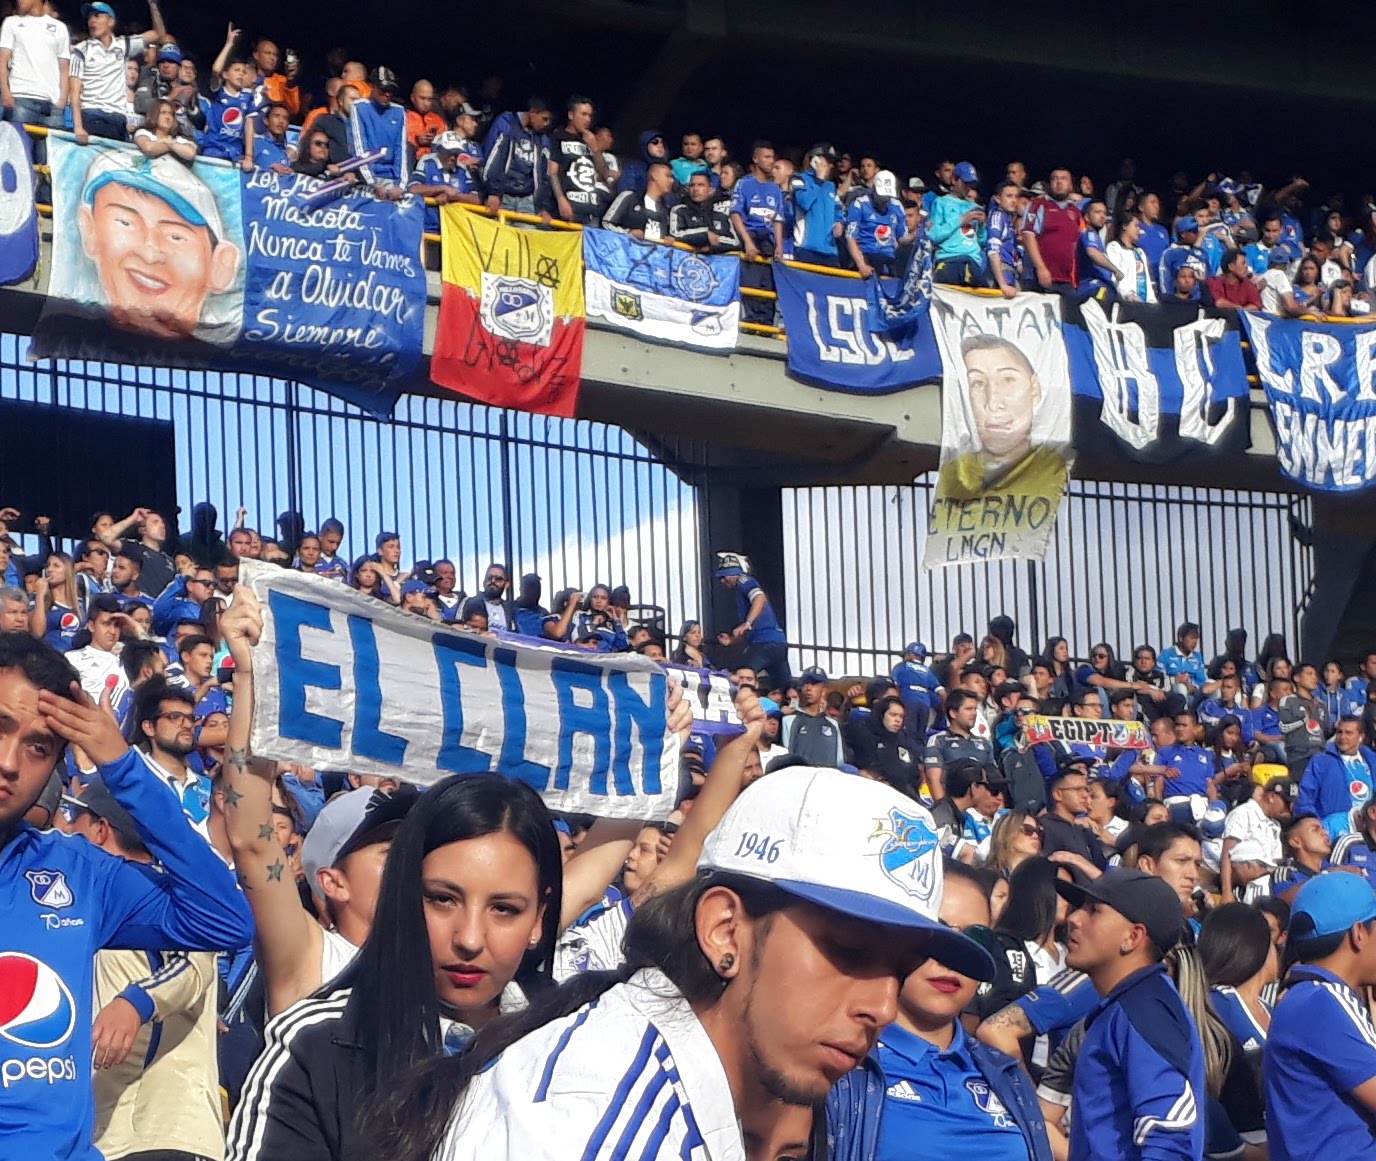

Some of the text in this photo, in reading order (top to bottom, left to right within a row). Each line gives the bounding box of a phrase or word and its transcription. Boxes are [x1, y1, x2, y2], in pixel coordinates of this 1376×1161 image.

[261, 195, 366, 231] Mascota
[248, 221, 327, 262] Nunca
[326, 233, 362, 262] te
[301, 264, 406, 324] Olvidar
[245, 308, 384, 350] Siempre
[928, 494, 1051, 536] ETERNO
[946, 533, 1007, 563] LMGN
[269, 588, 667, 797] EL CLAN
[734, 831, 785, 864] 1946
[1, 1054, 77, 1089] pepsi
